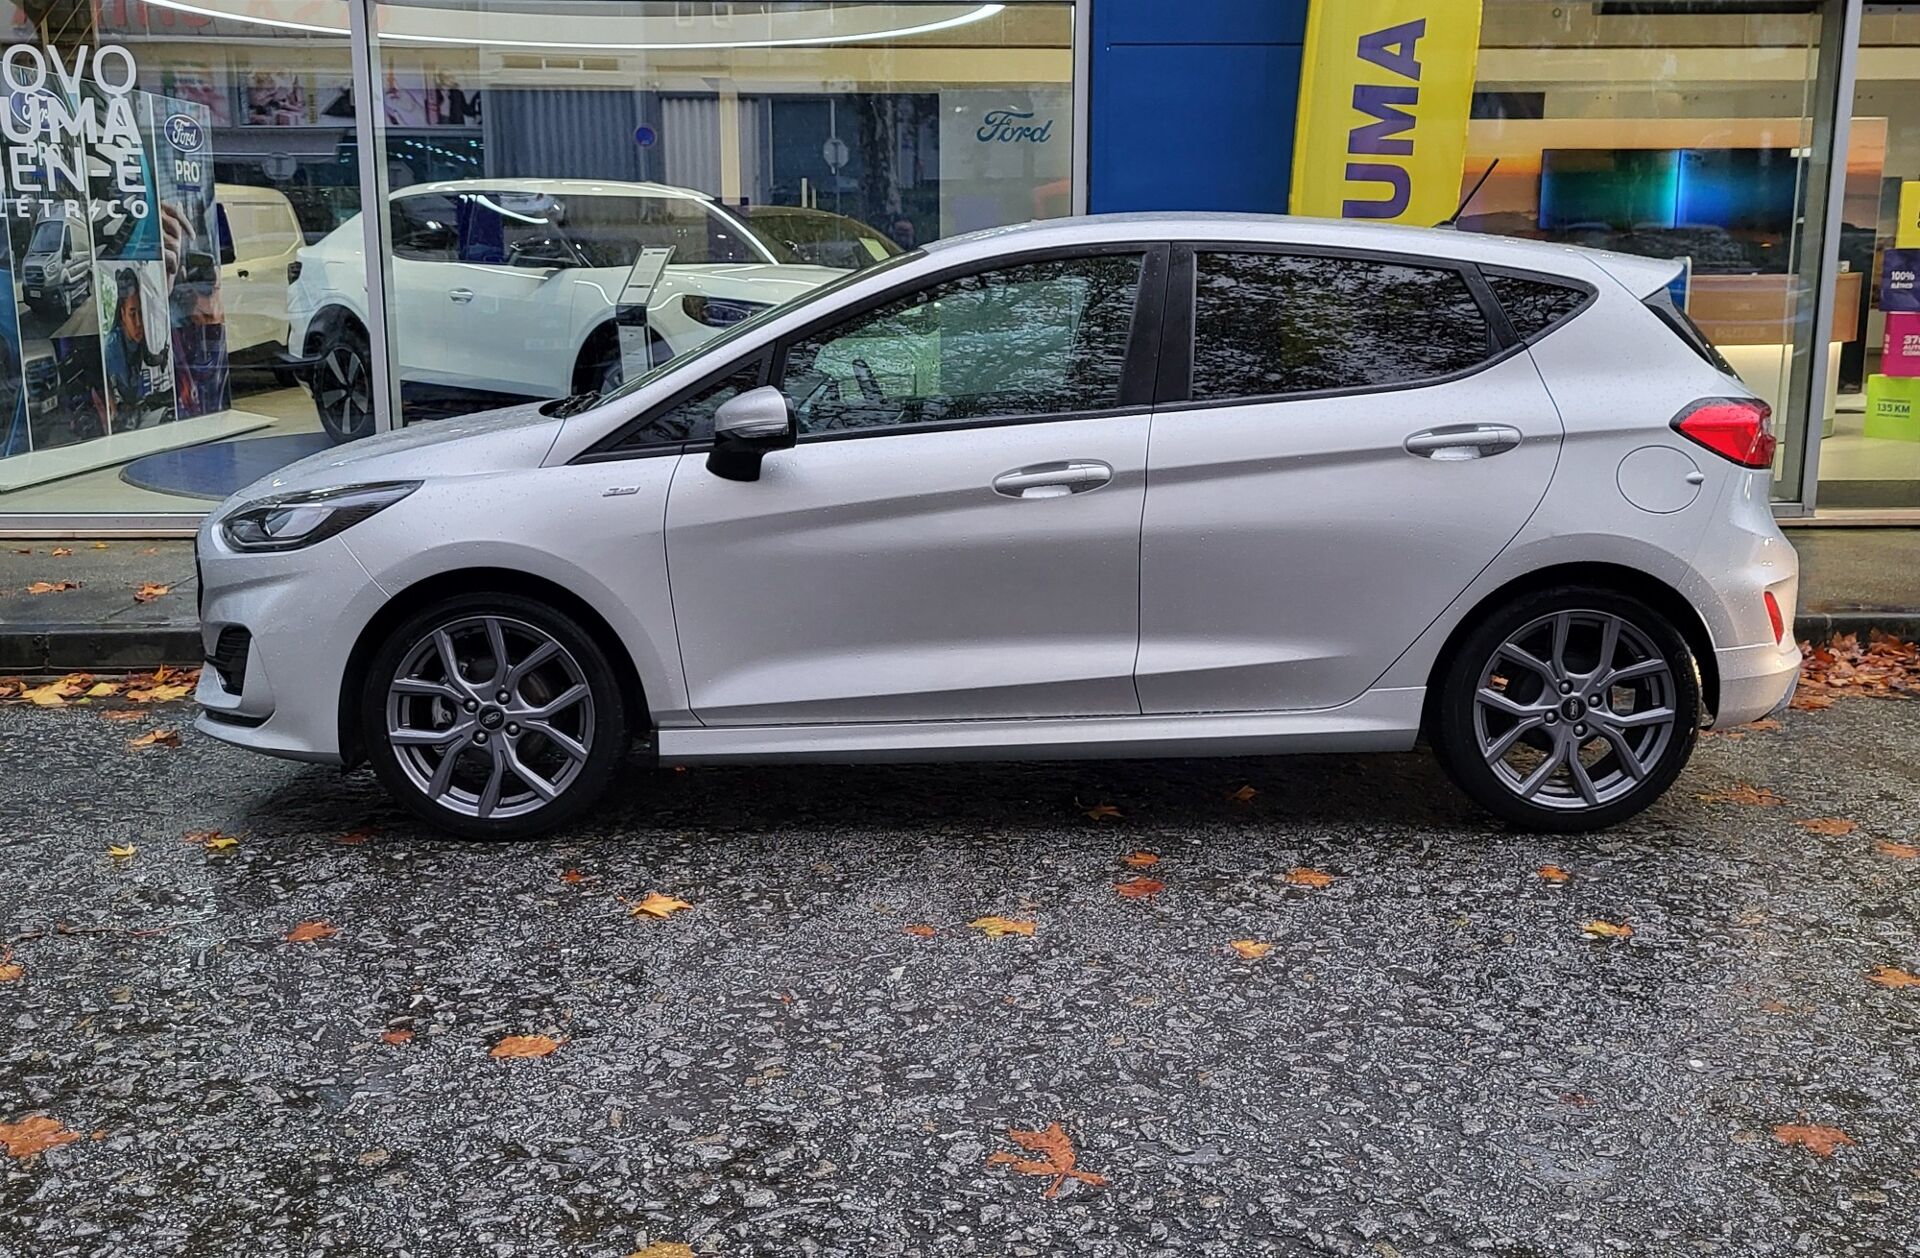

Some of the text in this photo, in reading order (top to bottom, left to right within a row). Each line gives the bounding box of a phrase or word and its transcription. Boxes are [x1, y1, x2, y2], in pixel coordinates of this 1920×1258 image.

[2, 44, 137, 95] OVO
[0, 96, 142, 144] UMA
[172, 118, 198, 147] Ford
[977, 110, 1054, 142] Ford
[1342, 18, 1427, 219] UMA
[175, 159, 200, 183] PRO
[1891, 270, 1915, 281] 100%
[1877, 403, 1910, 413] 135 KM
